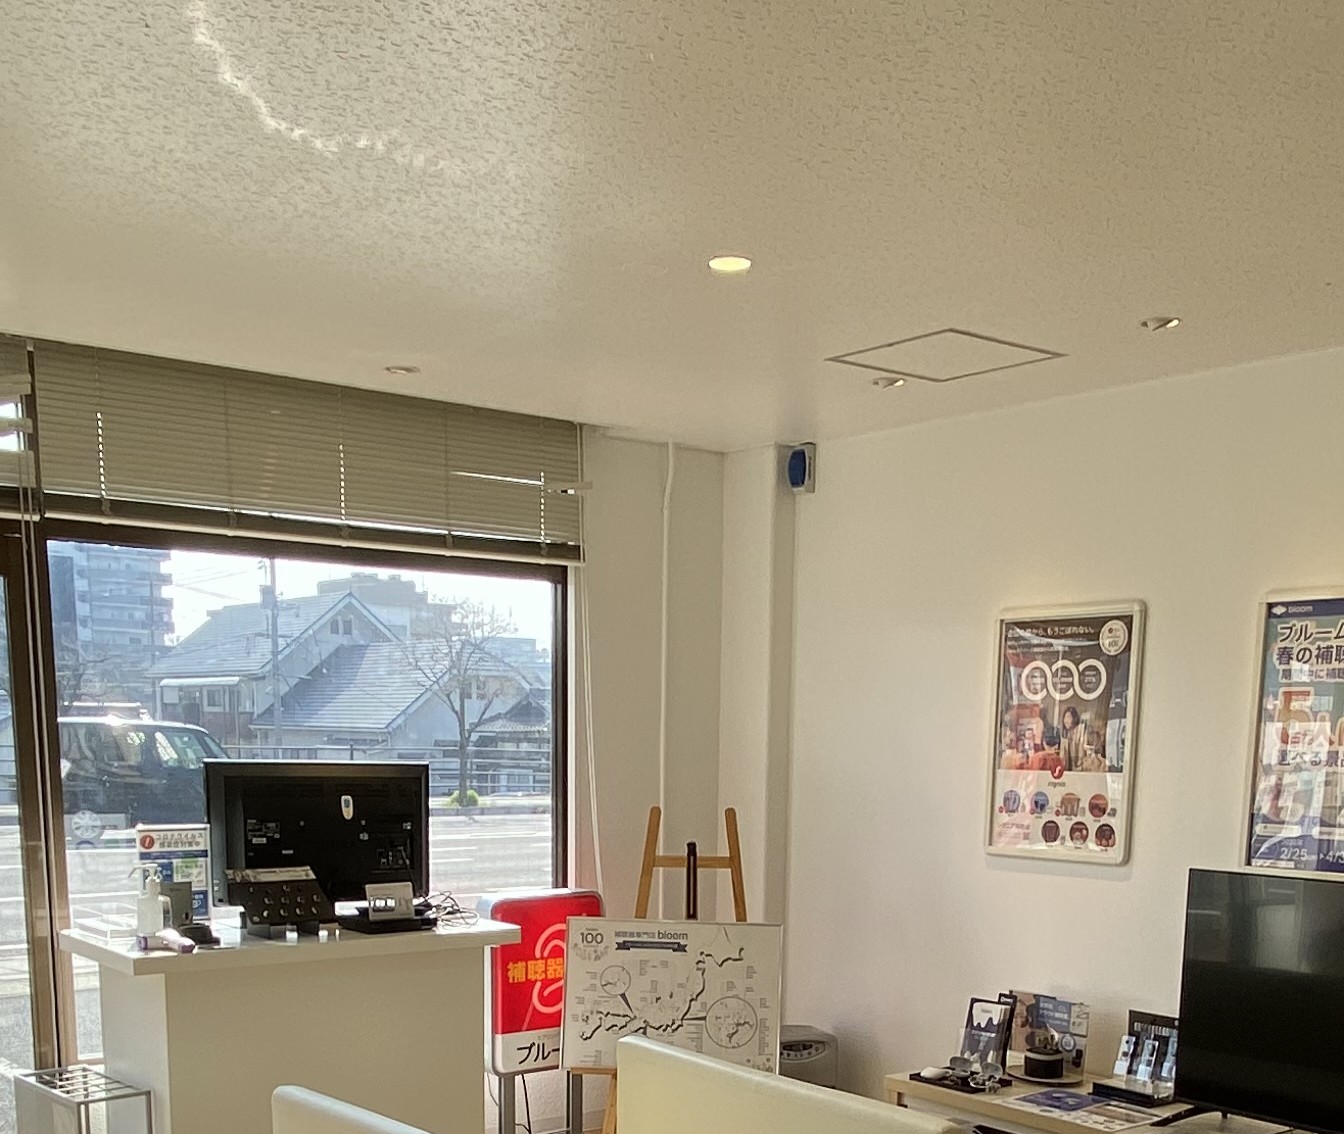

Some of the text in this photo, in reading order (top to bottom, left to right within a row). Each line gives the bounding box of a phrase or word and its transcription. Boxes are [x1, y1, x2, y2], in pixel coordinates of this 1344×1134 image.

[1287, 605, 1313, 613] bloom
[580, 931, 604, 944] 100
[657, 930, 688, 941] bloom
[506, 957, 565, 984] 補聴器
